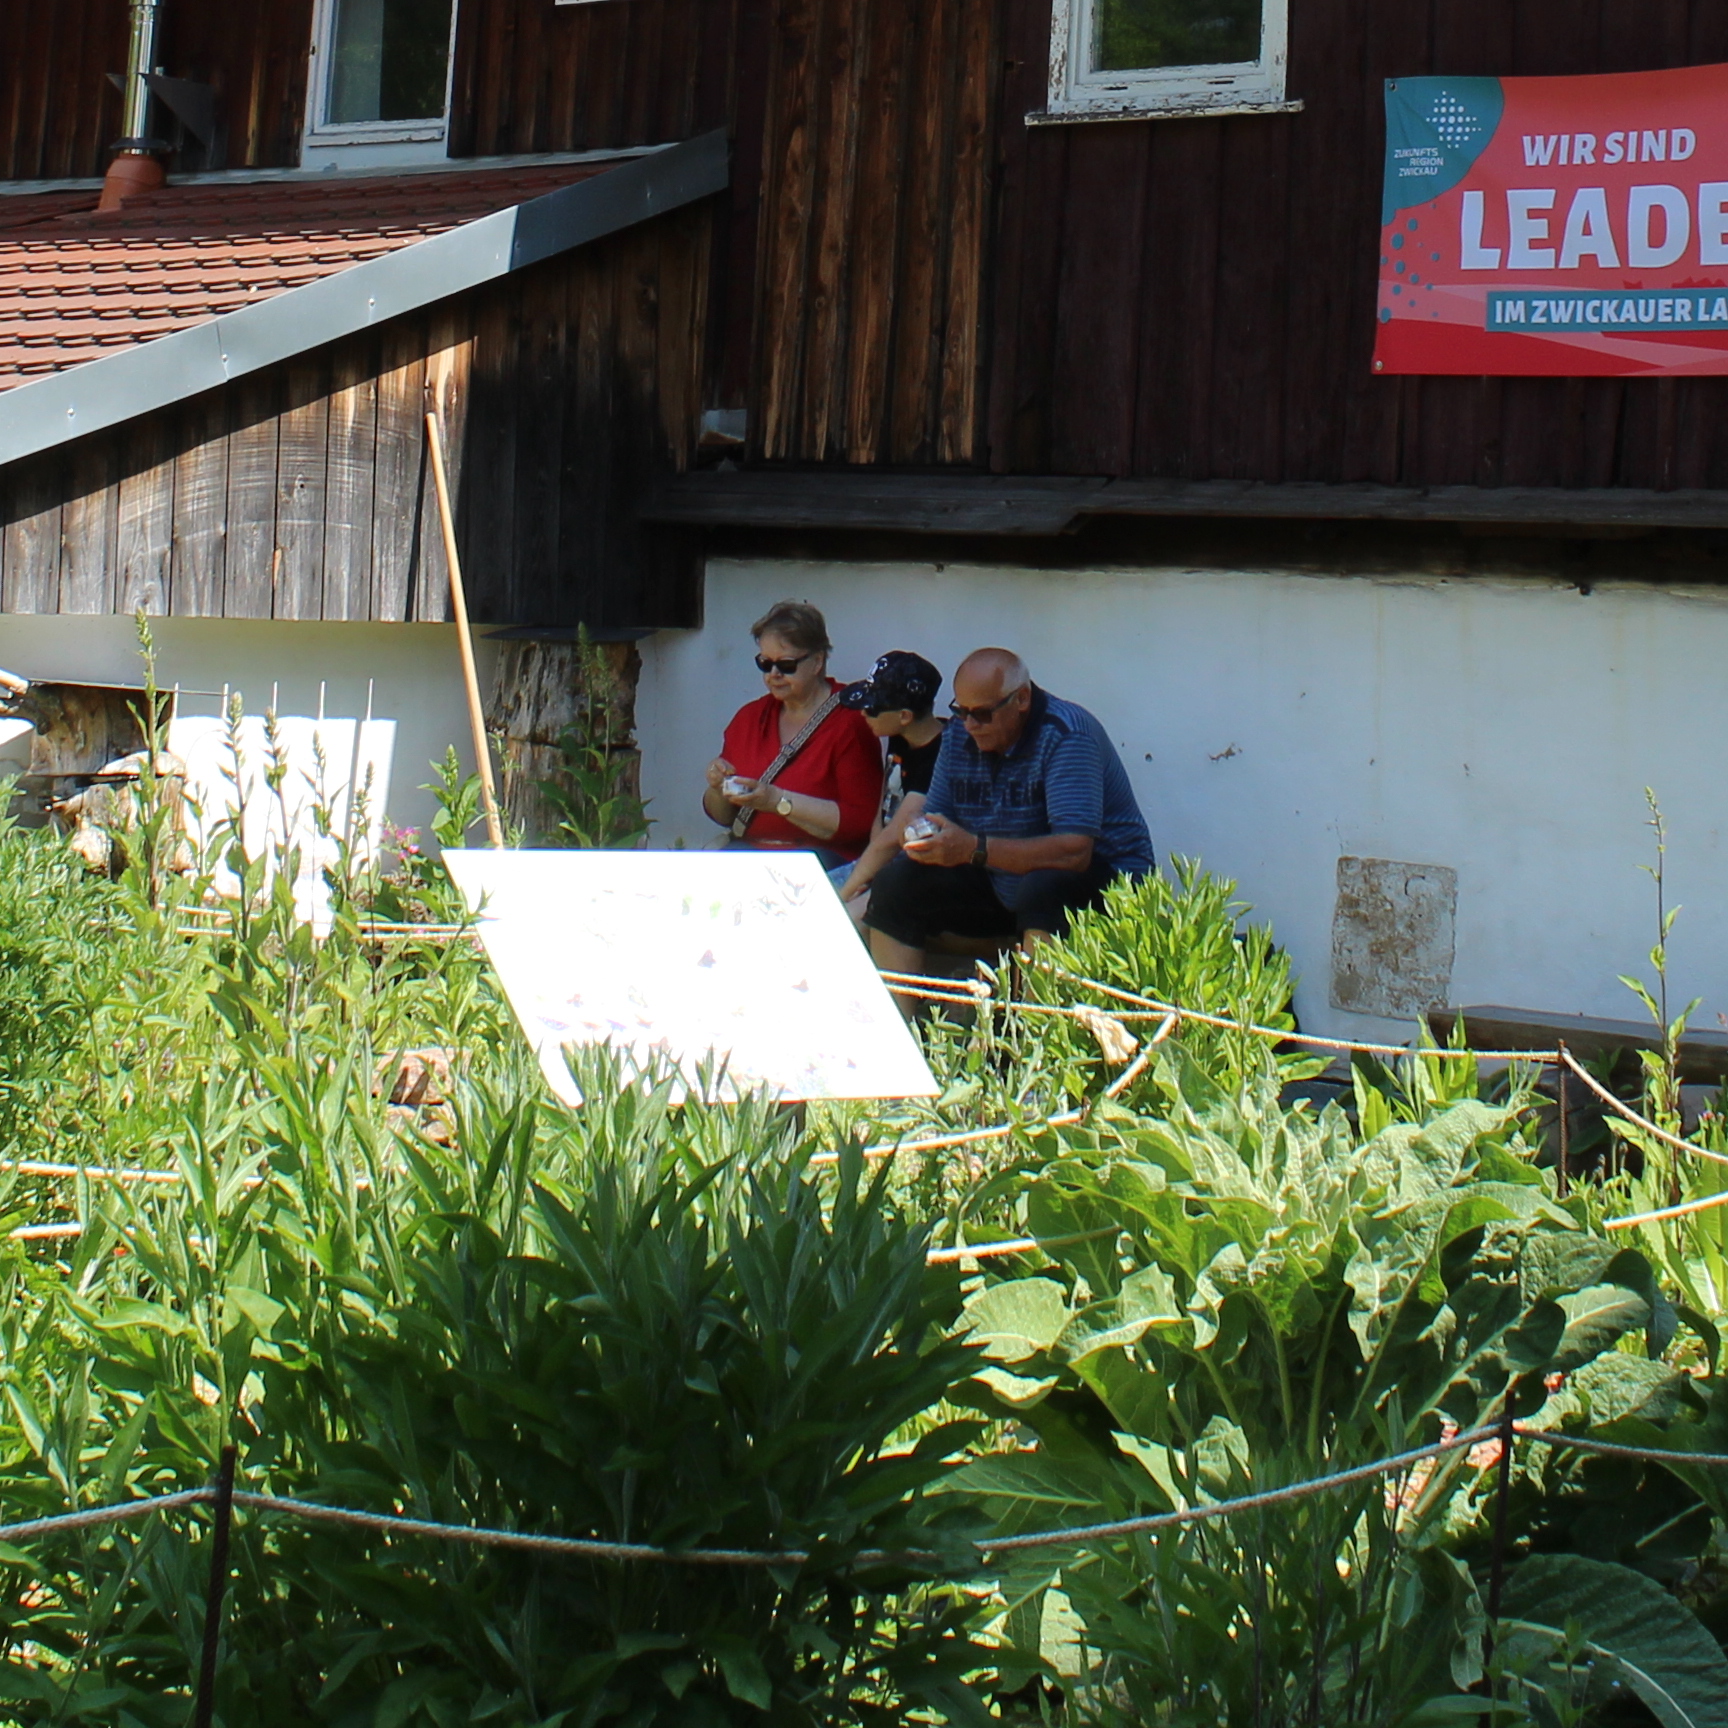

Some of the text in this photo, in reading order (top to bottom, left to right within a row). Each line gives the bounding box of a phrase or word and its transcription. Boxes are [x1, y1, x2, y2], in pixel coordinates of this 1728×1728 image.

[1522, 128, 1697, 167] WIR SIND
[1494, 298, 1527, 325] IM
[1529, 296, 1693, 325] ZWICKAUER
